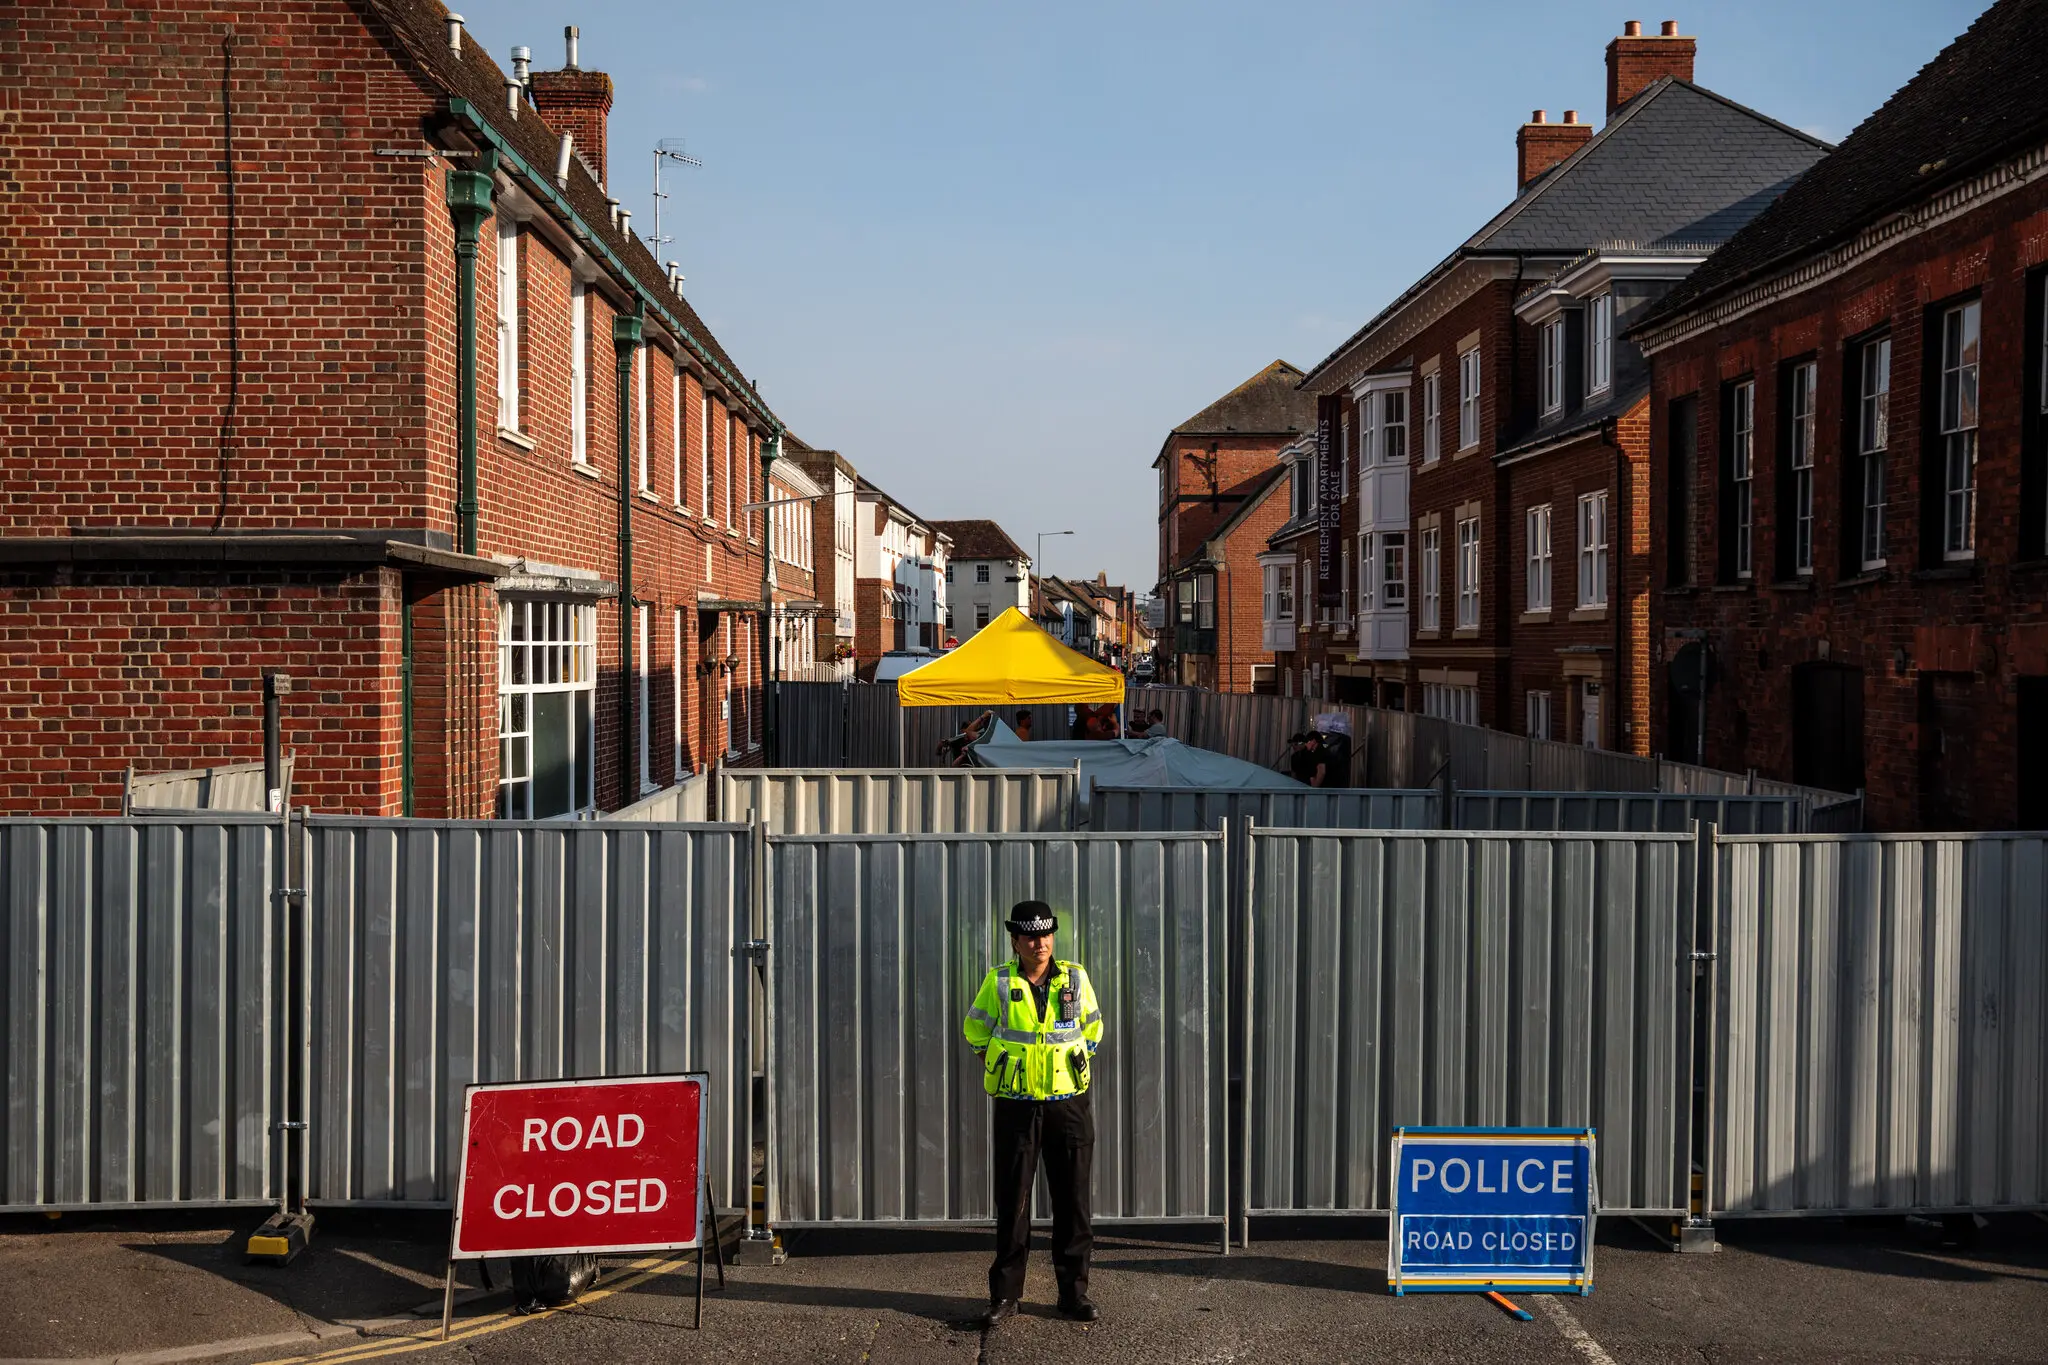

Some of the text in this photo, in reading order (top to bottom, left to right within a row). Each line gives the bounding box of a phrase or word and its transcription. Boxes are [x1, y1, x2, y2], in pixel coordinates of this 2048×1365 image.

[1320, 420, 1329, 579] RETIREMENT APARTMENTS
[1331, 471, 1340, 528] FOR SALE
[1055, 1021, 1074, 1029] POLICE
[524, 1114, 645, 1152] ROAD
[1411, 1158, 1574, 1193] POLICE
[493, 1178, 668, 1220] CLOSED
[1407, 1231, 1576, 1251] ROAD CLOSED
